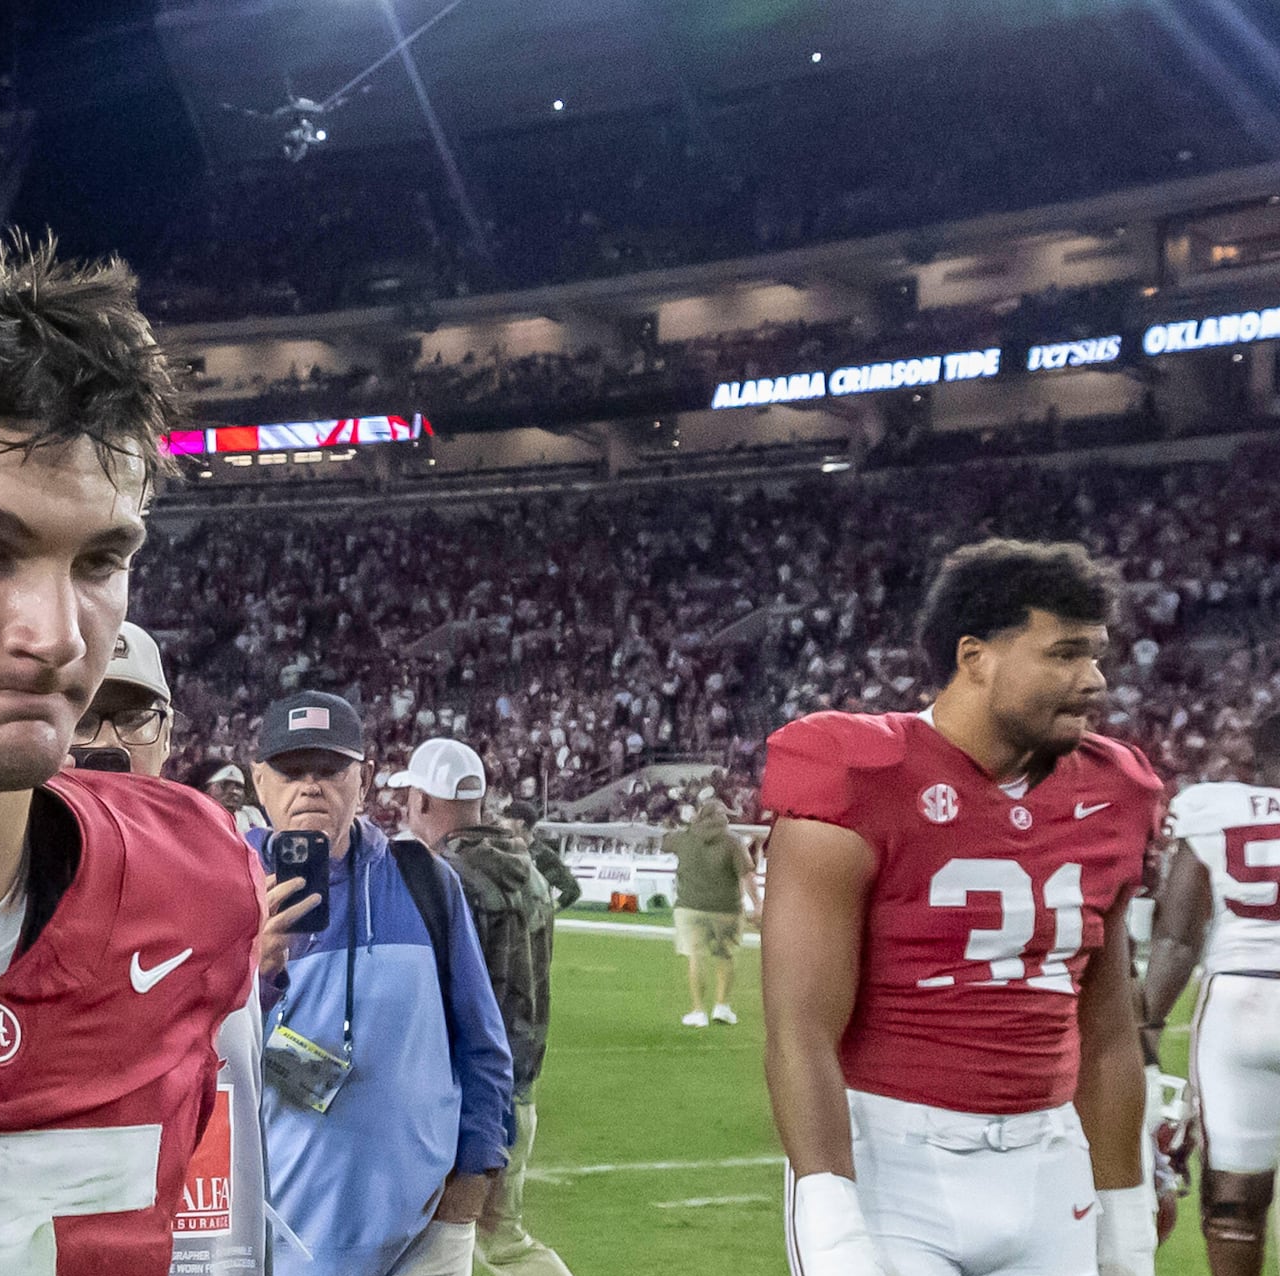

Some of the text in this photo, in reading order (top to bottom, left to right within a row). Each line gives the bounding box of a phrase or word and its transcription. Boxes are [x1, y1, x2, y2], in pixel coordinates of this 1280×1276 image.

[1027, 335, 1121, 371] versus
[711, 348, 1002, 409] ALABAMA CRIMSON TIDE
[917, 858, 1086, 994] 31
[182, 1176, 230, 1211] ALFA
